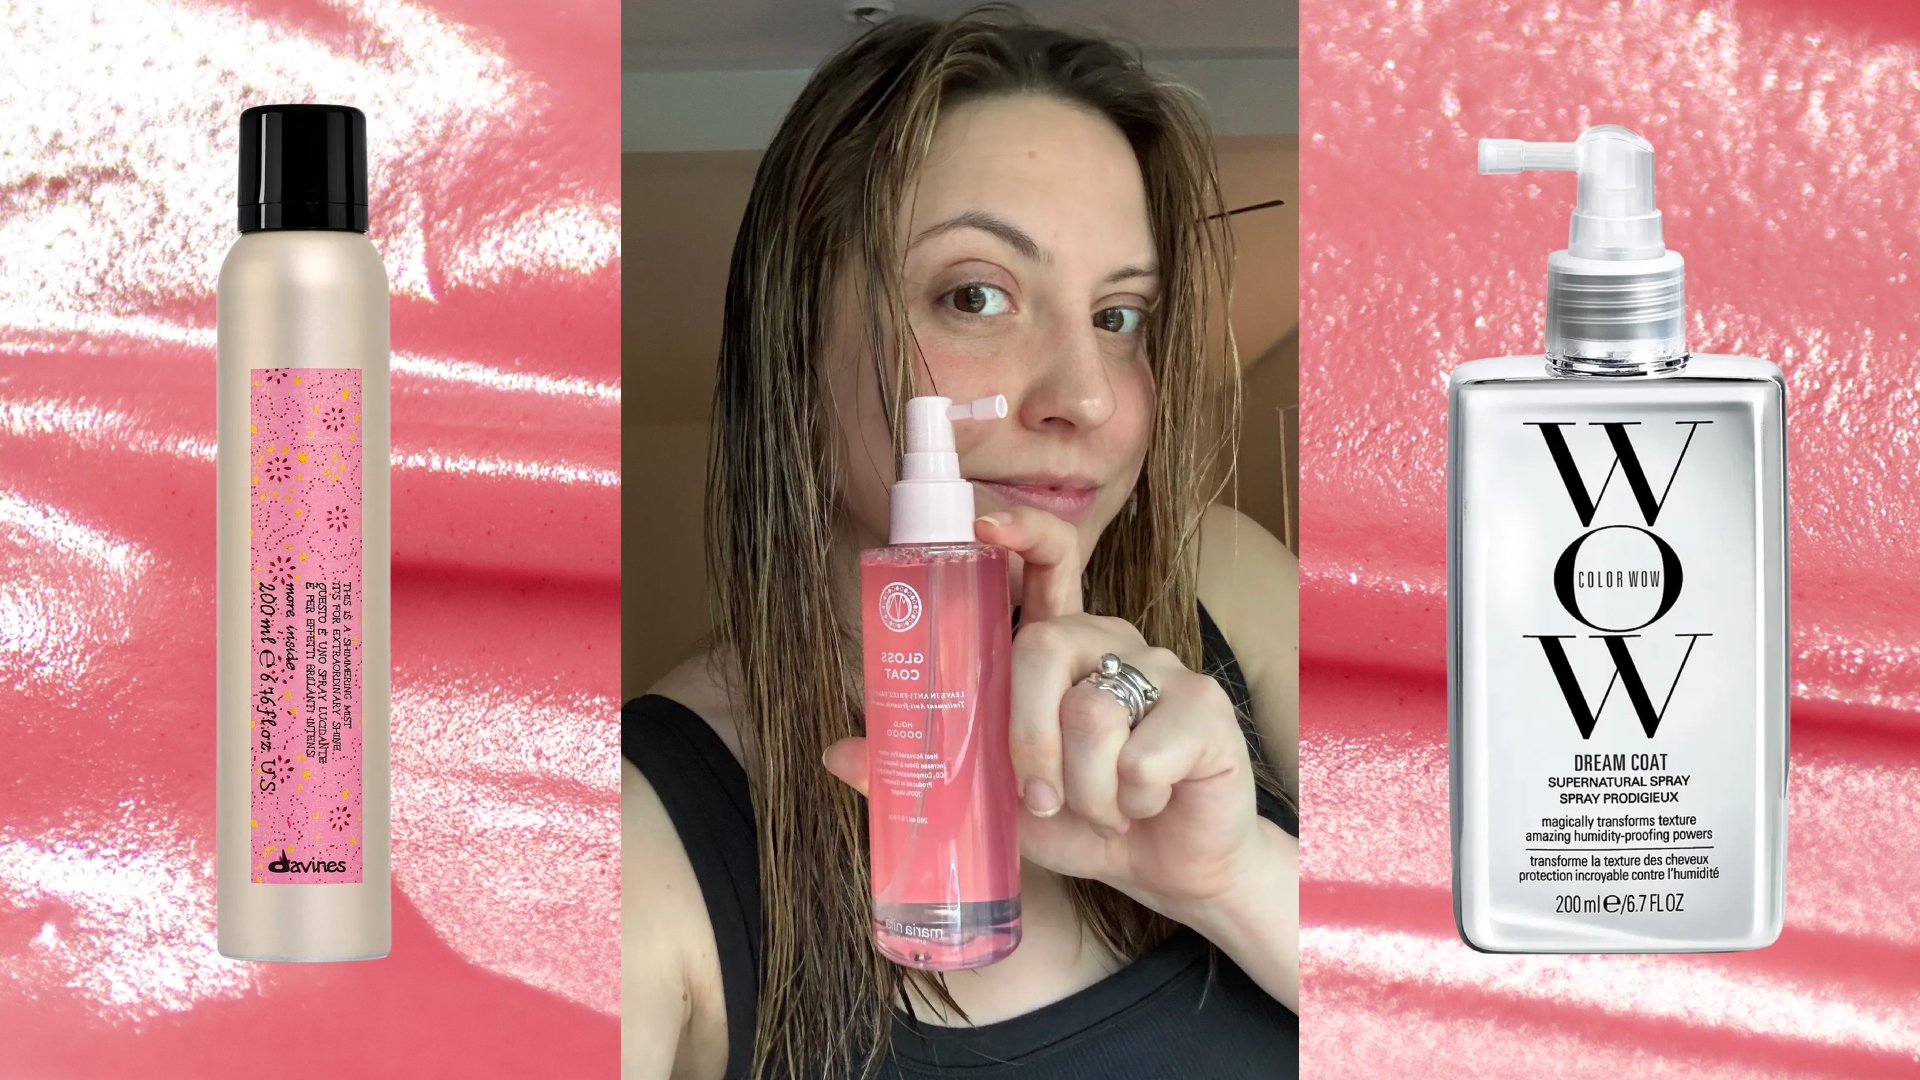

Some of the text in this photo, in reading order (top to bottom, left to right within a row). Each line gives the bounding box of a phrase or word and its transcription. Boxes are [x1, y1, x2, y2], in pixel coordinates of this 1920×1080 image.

[1578, 570, 1660, 588] COLOR WOW
[306, 595, 314, 613] PER
[317, 583, 327, 623] QUESTO
[343, 582, 352, 606] THIS
[286, 583, 298, 671] more inside
[343, 611, 353, 620] IS
[306, 619, 315, 659] EFFETTI
[318, 642, 326, 664] UNO
[332, 582, 341, 751] IT'S FOR EXTRAORDINARY SHINE
[343, 638, 351, 700] SHIMMERING
[306, 664, 315, 713] BRILLANTI
[317, 669, 327, 701] SPRAY
[343, 704, 352, 729] MIST
[306, 719, 315, 758] INTENSI
[318, 706, 327, 764] LUCIDANTE
[1574, 754, 1668, 772] DREAM COAT
[259, 759, 276, 794] U.S.
[1548, 775, 1691, 788] SUPERNATURAL SPRAY
[1559, 792, 1679, 804] SPRAY PRODIGIEUX
[1542, 815, 1697, 830] magically transforms texture
[1526, 828, 1713, 844] amazing humidity-proofing powers
[268, 849, 346, 873] davines
[1530, 853, 1709, 867] transforme la texture des cheveux
[1519, 867, 1719, 883] protection incroyable contre l'humidité
[1556, 895, 1581, 913] 200
